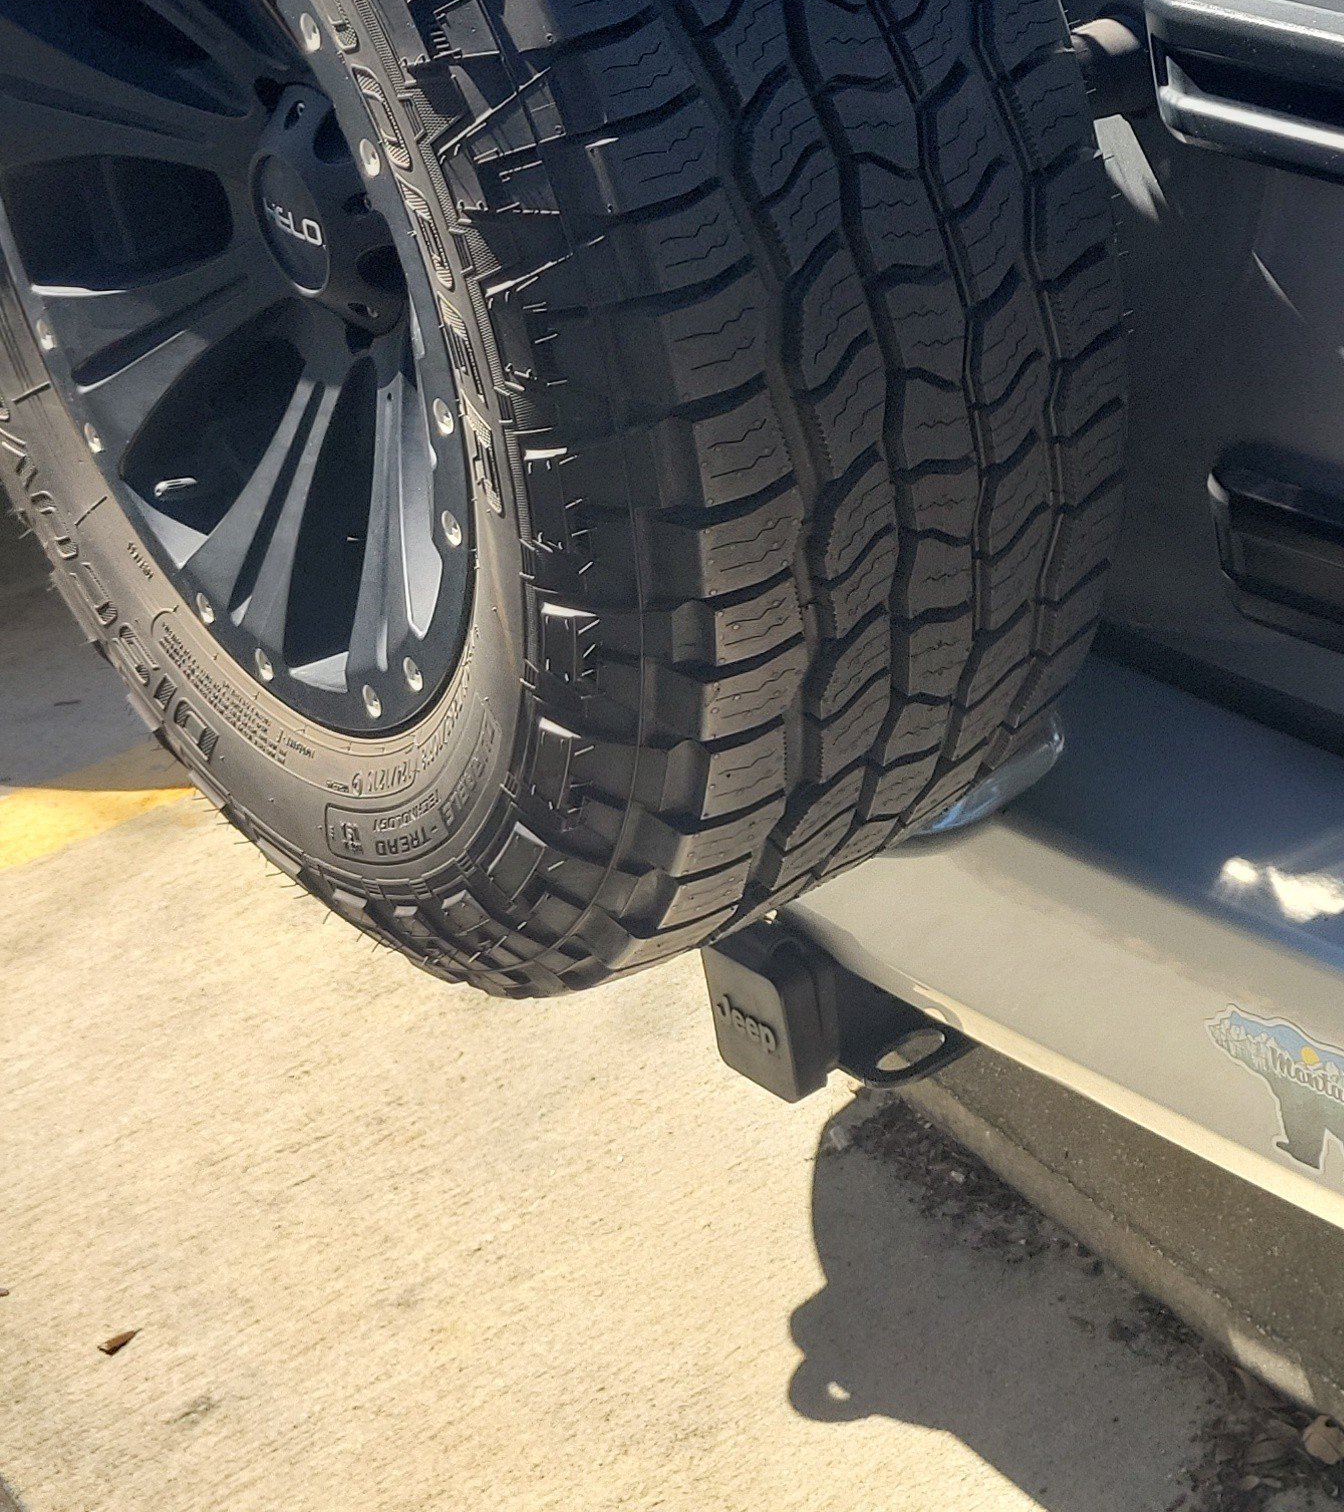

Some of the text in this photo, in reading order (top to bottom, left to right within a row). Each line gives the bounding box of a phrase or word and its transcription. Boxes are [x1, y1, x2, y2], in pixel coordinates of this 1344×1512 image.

[262, 197, 323, 247] HELO
[0, 394, 220, 764] DISCOV
[716, 993, 779, 1055] Jeep
